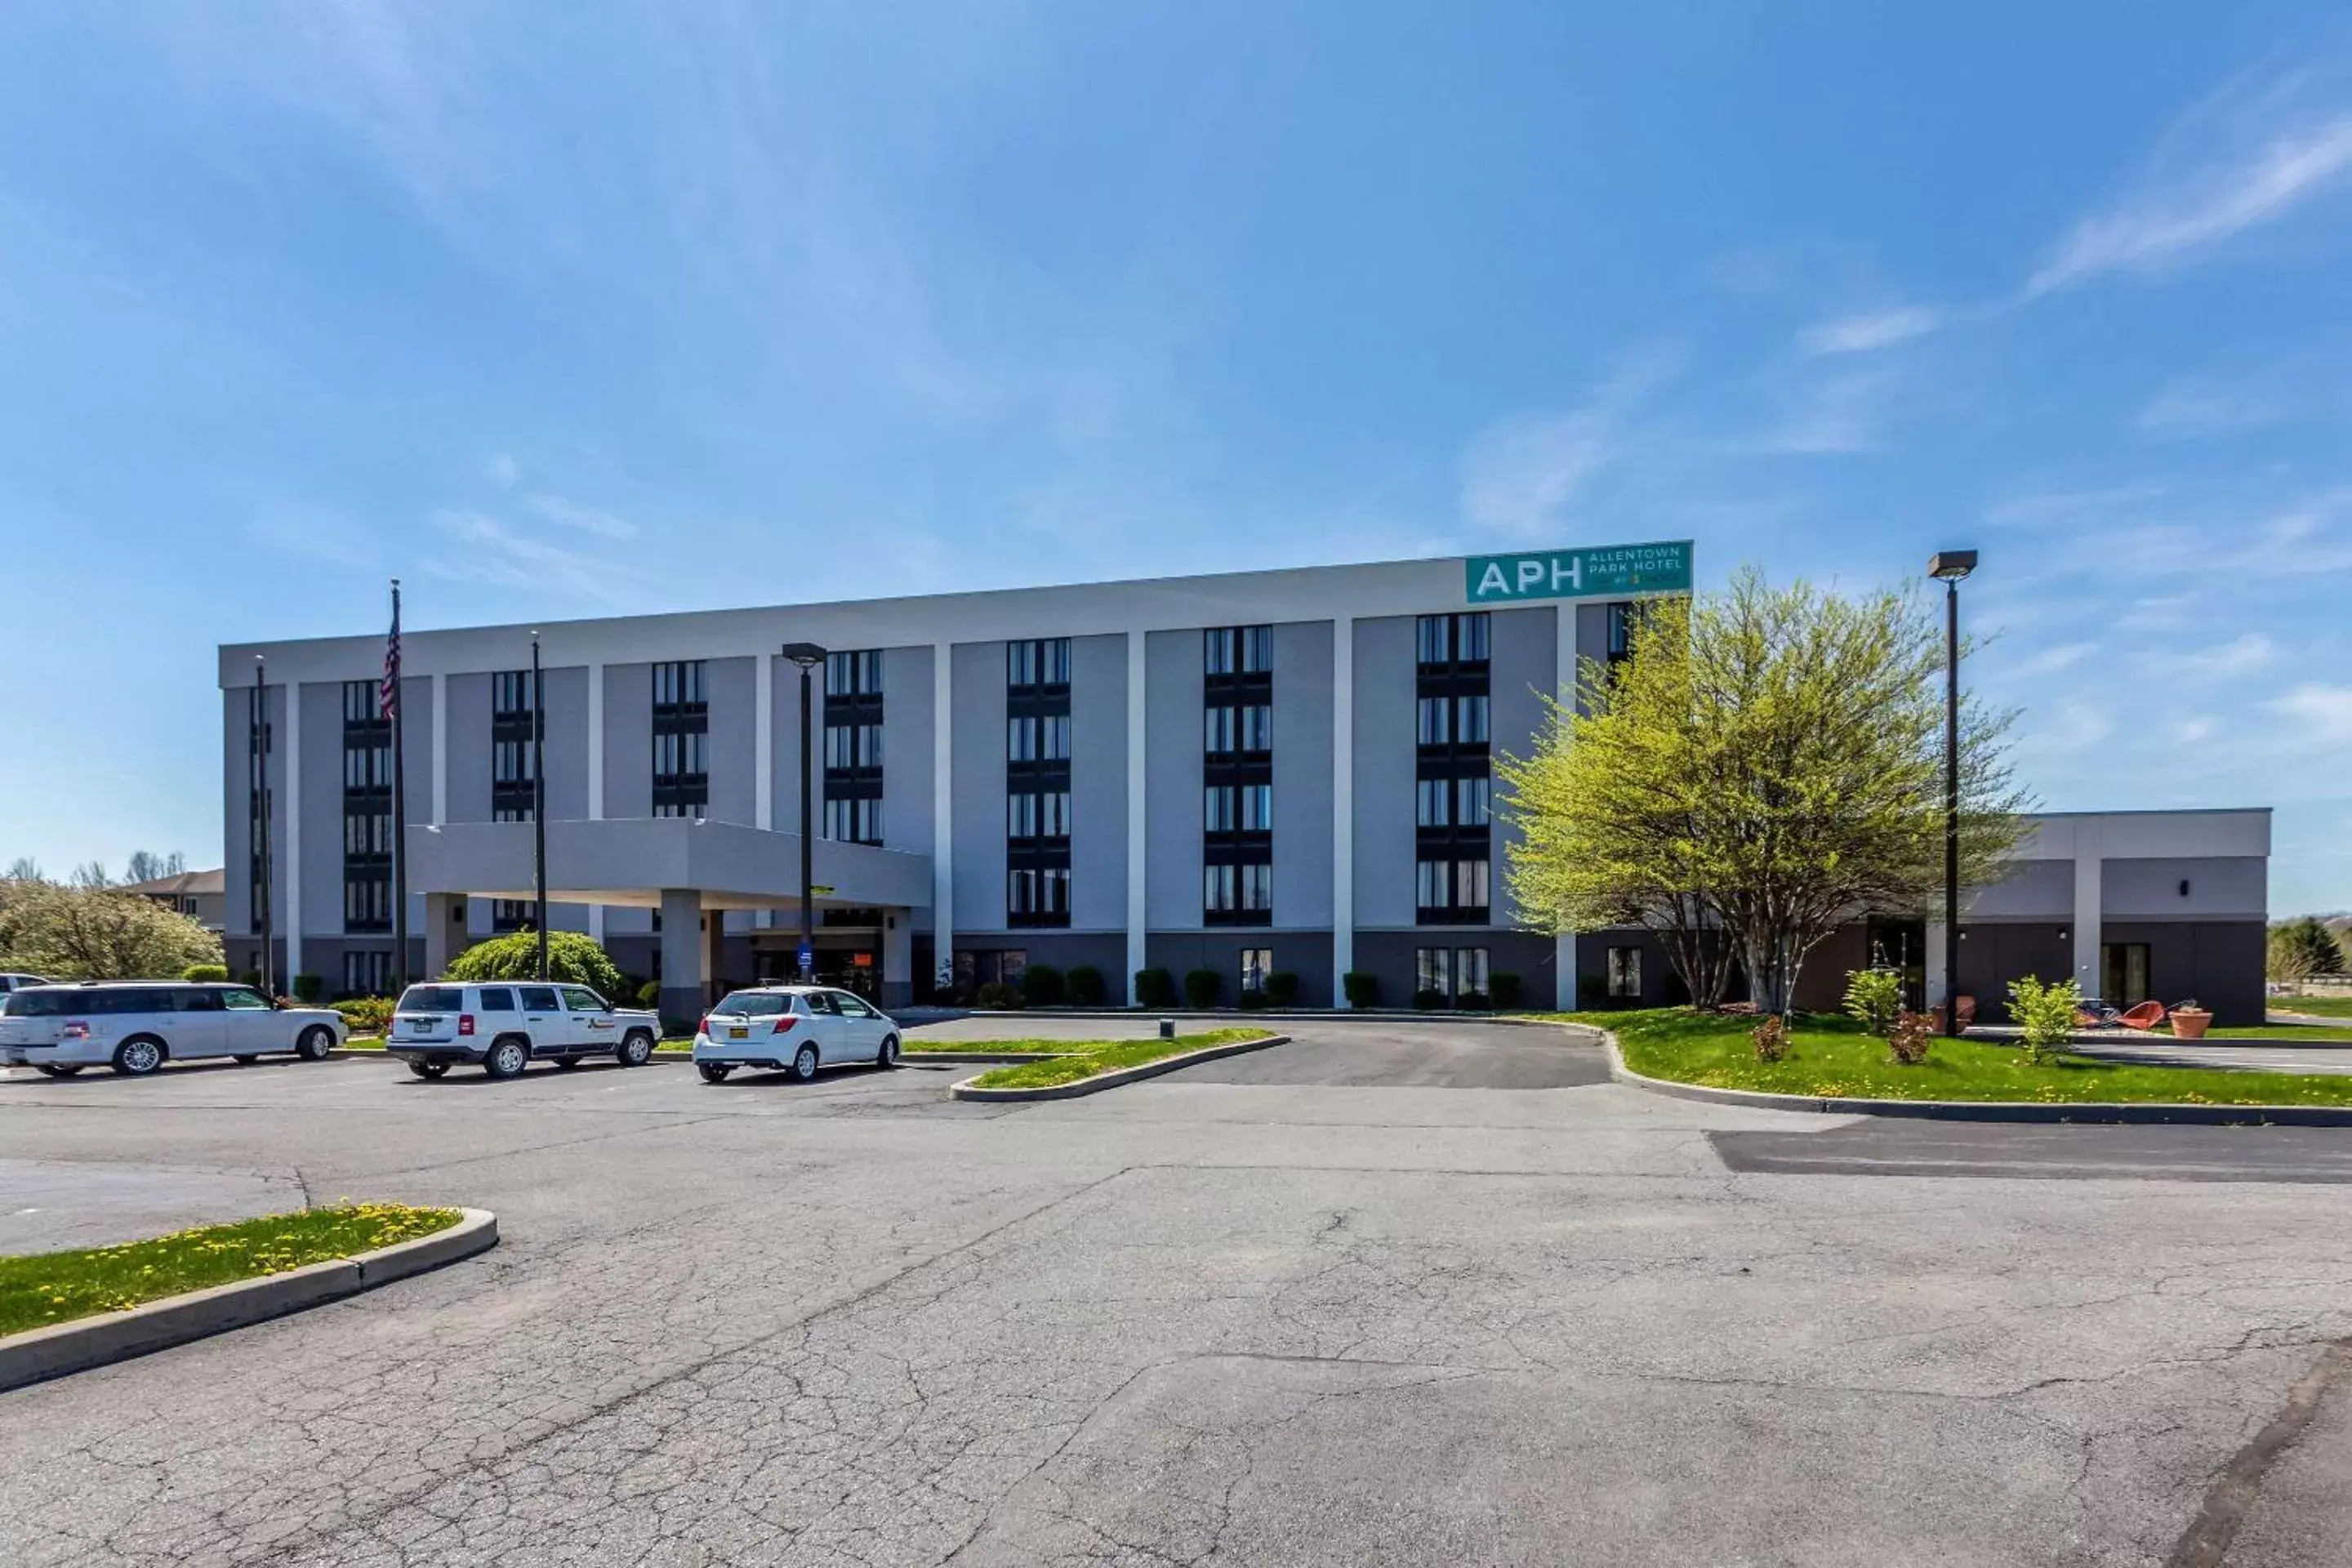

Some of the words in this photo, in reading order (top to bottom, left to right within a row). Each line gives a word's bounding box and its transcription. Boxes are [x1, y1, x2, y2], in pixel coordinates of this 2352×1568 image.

[1588, 547, 1680, 563] ALLENTOWN
[1589, 563, 1628, 573] PARK
[1634, 559, 1682, 571] HOTEL
[1477, 556, 1581, 595] APH
